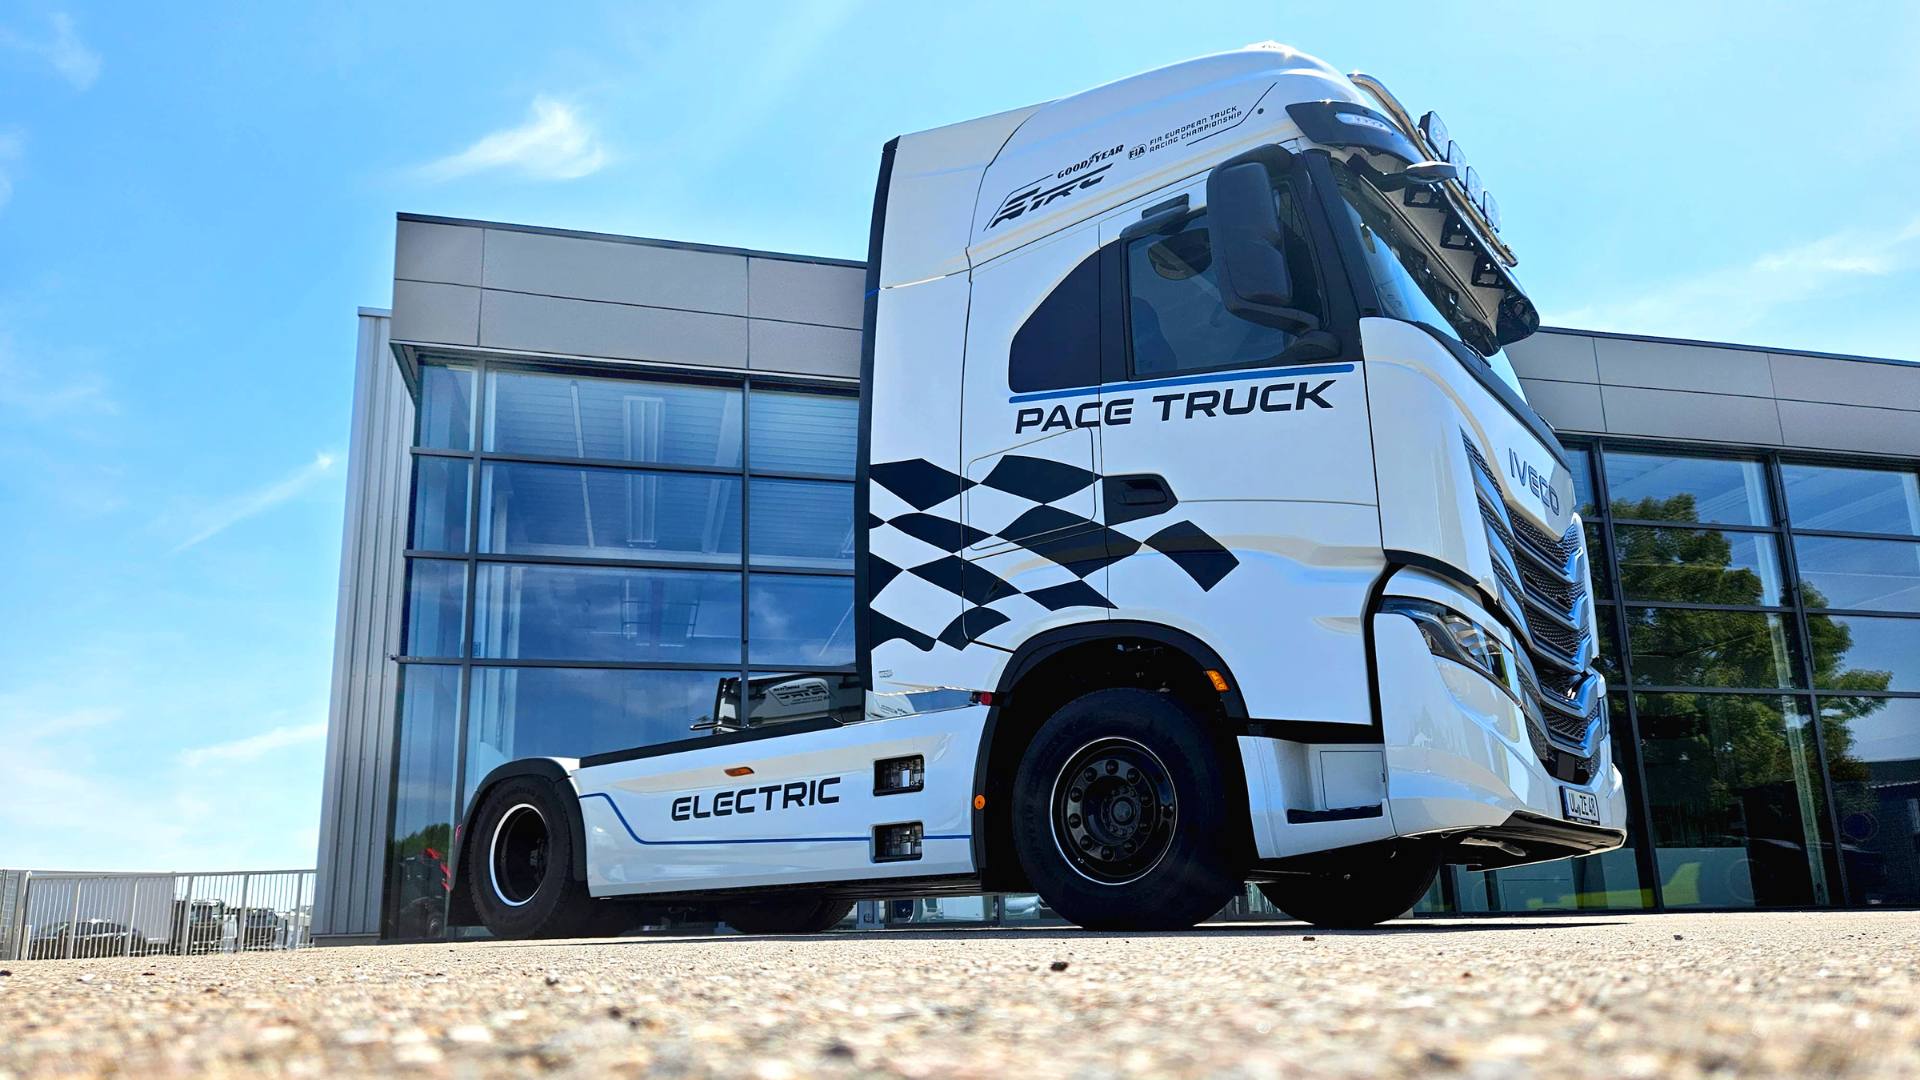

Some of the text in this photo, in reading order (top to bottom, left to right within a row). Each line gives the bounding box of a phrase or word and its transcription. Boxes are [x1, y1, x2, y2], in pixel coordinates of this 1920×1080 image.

[1149, 105, 1237, 146] FIA EUROPEAN TRUCK
[1149, 110, 1242, 153] RACING CHAMPIONSHIP
[1057, 144, 1124, 179] GOODYEAR
[1015, 379, 1337, 434] PACE TRUCK
[1508, 447, 1560, 516] IVECO
[671, 776, 842, 822] ELECTRIC
